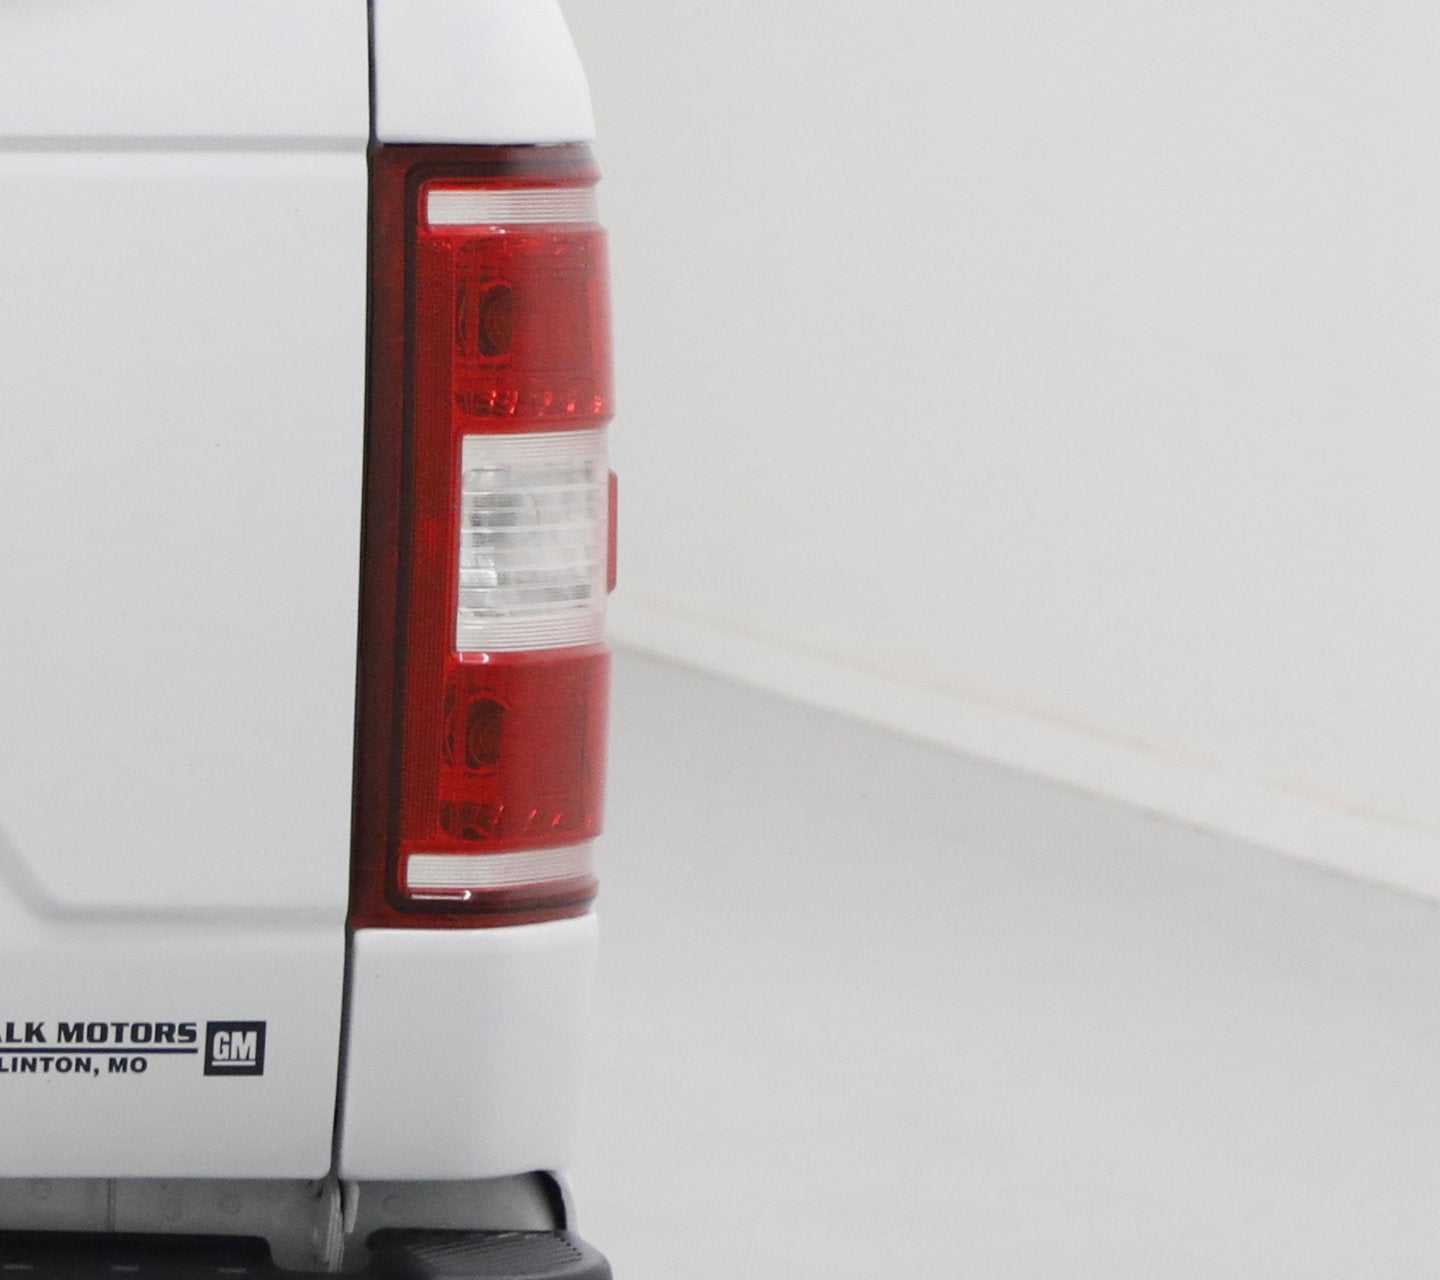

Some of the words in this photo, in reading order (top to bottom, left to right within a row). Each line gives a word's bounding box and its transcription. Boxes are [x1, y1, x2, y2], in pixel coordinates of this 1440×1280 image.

[57, 1021, 197, 1044] MOTORS
[212, 1030, 258, 1062] GM
[107, 1056, 148, 1074] MO
